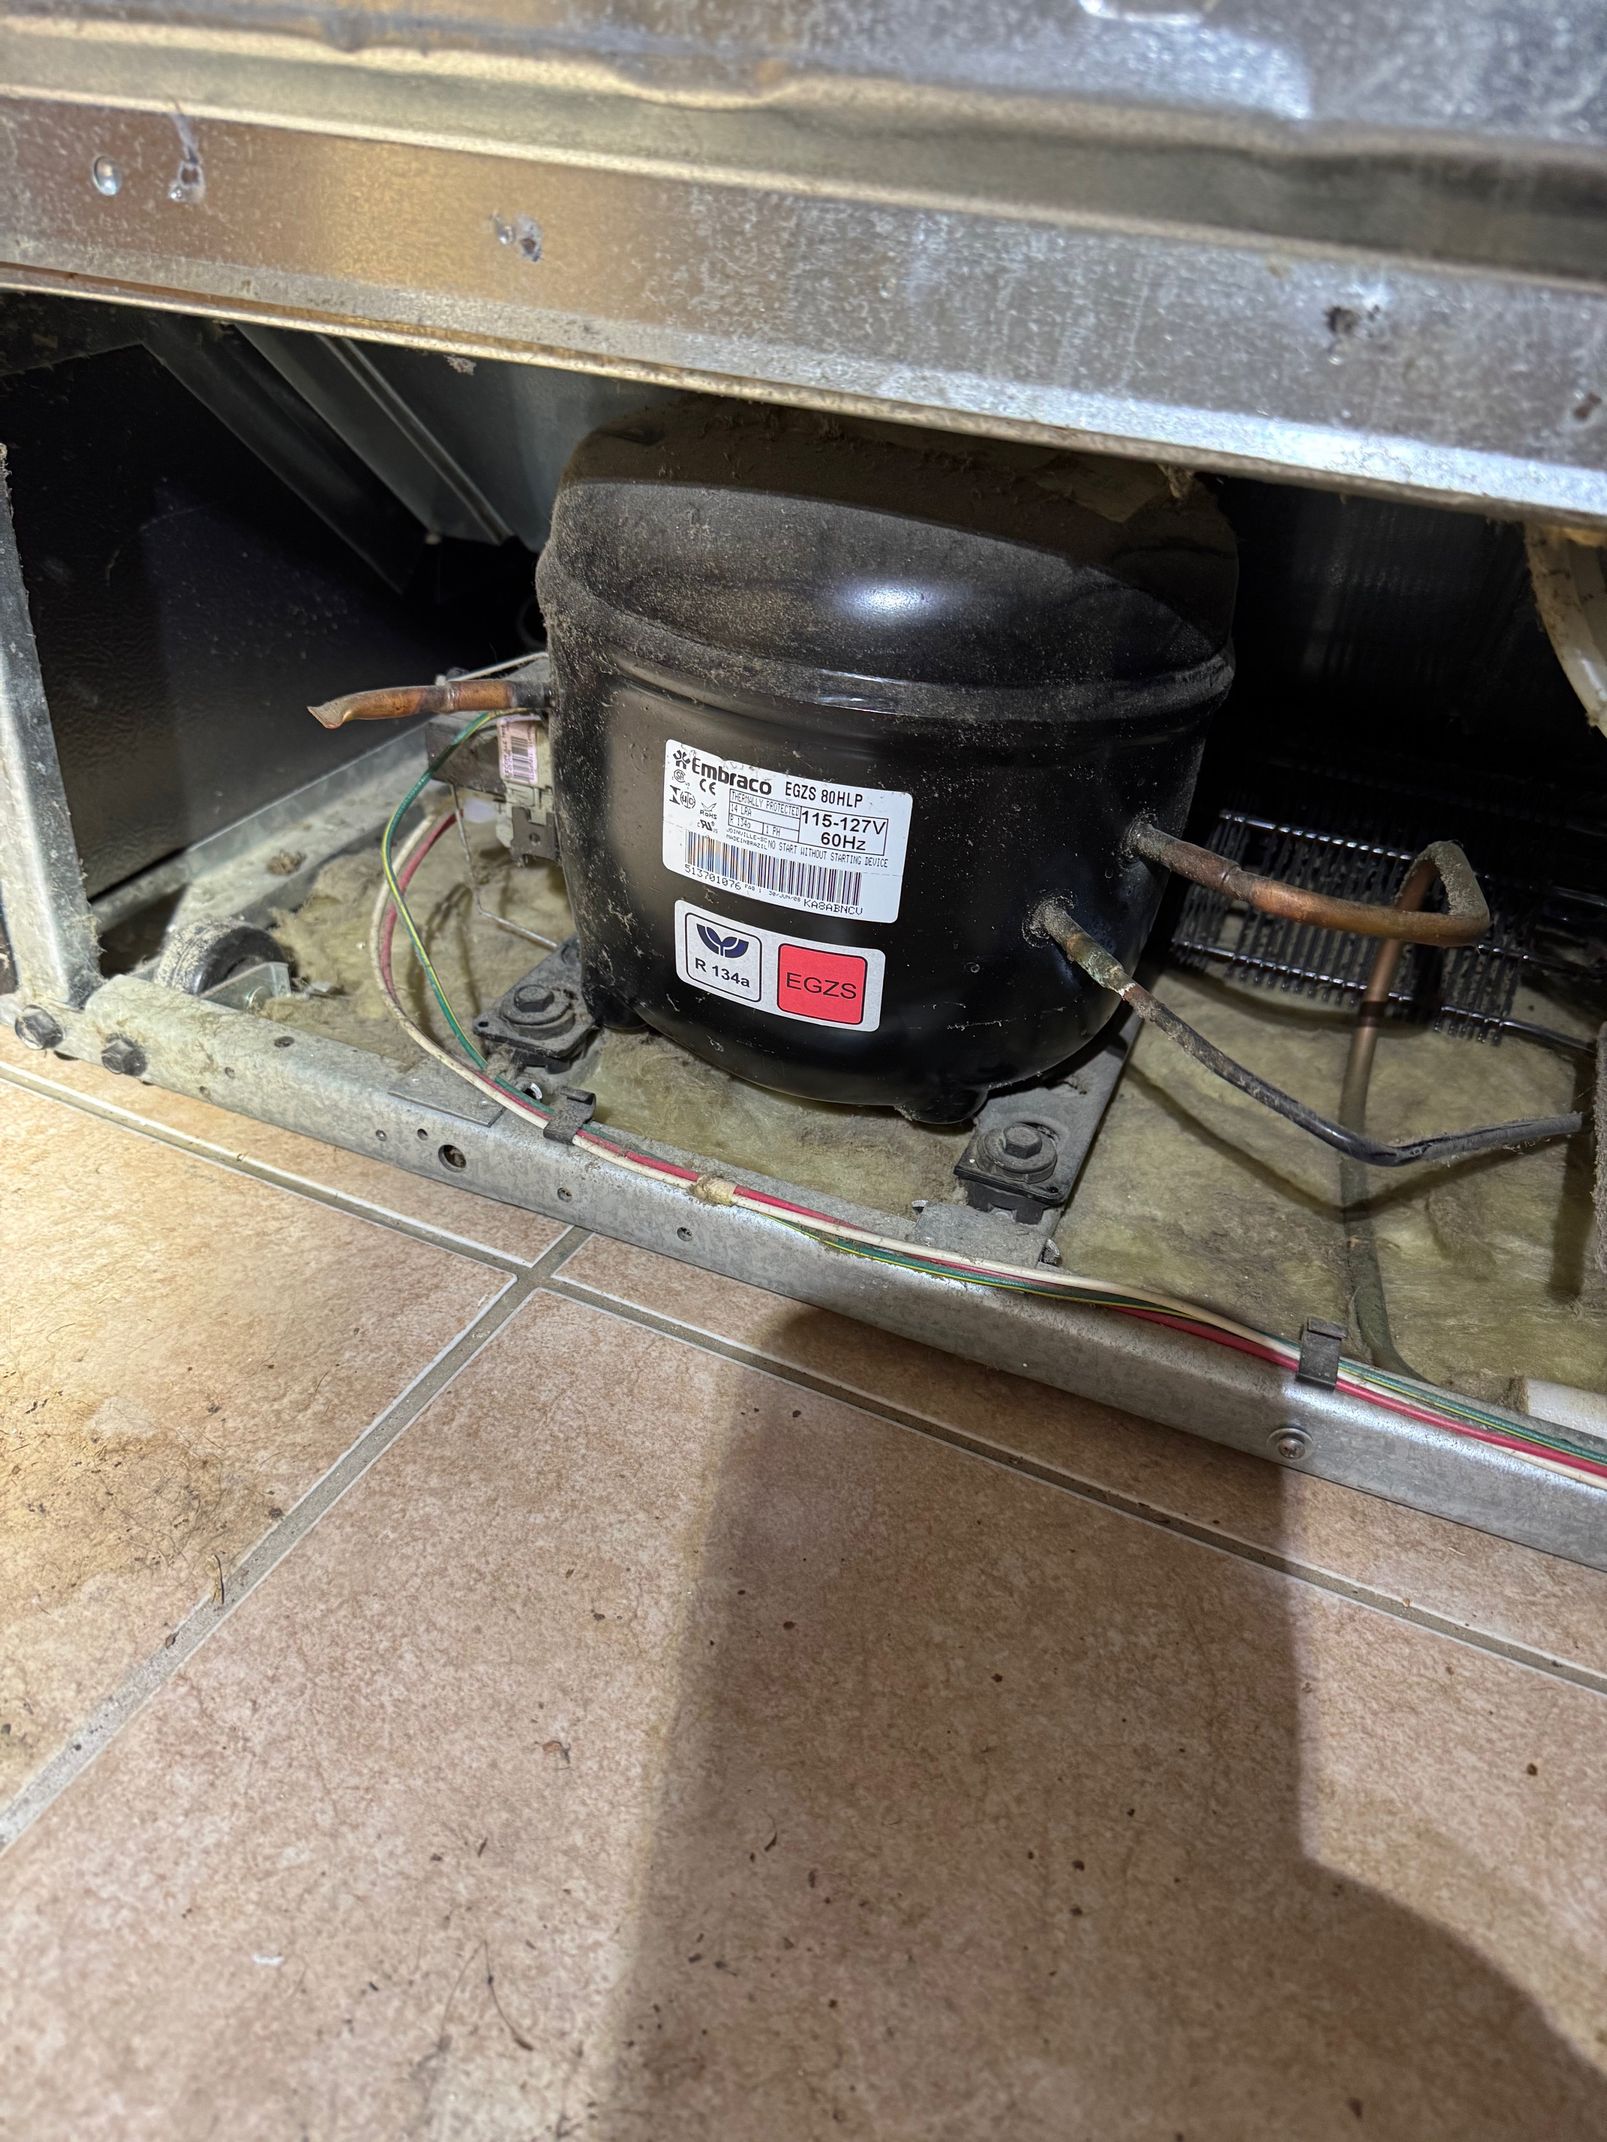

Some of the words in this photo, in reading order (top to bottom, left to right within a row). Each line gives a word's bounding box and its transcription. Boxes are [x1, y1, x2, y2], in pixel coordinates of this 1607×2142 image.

[692, 756, 772, 795] Embraco
[785, 782, 816, 800] EGZS
[821, 789, 863, 808] 80HLP
[731, 791, 764, 809] THERMALLY
[766, 800, 799, 817] PROTECTED
[731, 803, 738, 812] 14
[802, 810, 886, 835] 115-127V
[768, 840, 776, 849] NO
[779, 842, 798, 854] START
[800, 847, 826, 862] WITHOUT
[830, 852, 861, 865] STARTING
[864, 857, 888, 868] DEVICE
[821, 832, 866, 851] 60Hz
[684, 864, 742, 890] 513701076
[804, 899, 863, 915] KA8ABNCV
[695, 958, 706, 972] R
[712, 965, 751, 987] 134a
[786, 972, 857, 999] EGZS
